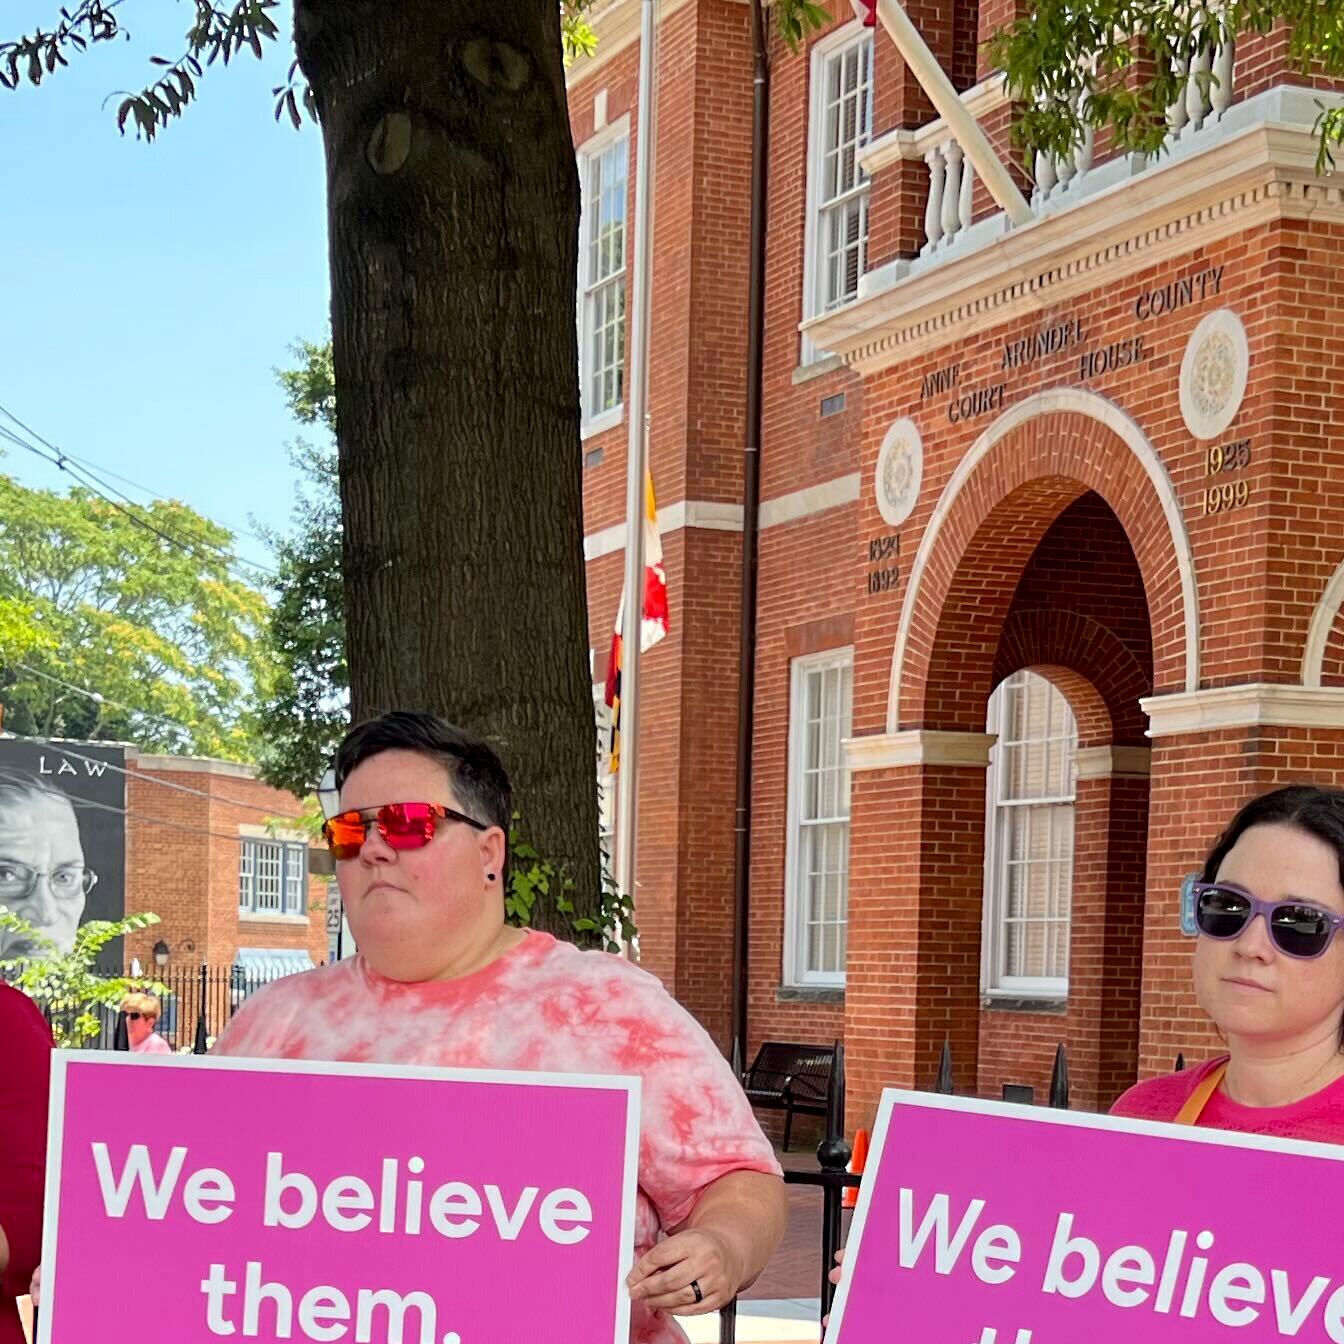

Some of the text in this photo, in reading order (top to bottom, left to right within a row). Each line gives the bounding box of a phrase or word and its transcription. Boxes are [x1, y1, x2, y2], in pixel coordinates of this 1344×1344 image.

[919, 265, 1225, 399] ANNE ARUNDEL COUNTY
[948, 335, 1147, 424] COURT HOUSE
[1202, 480, 1249, 516] 1999
[1204, 438, 1251, 477] 1925
[39, 755, 108, 777] LAW
[90, 1142, 594, 1246] We believe
[898, 1186, 1023, 1286] We
